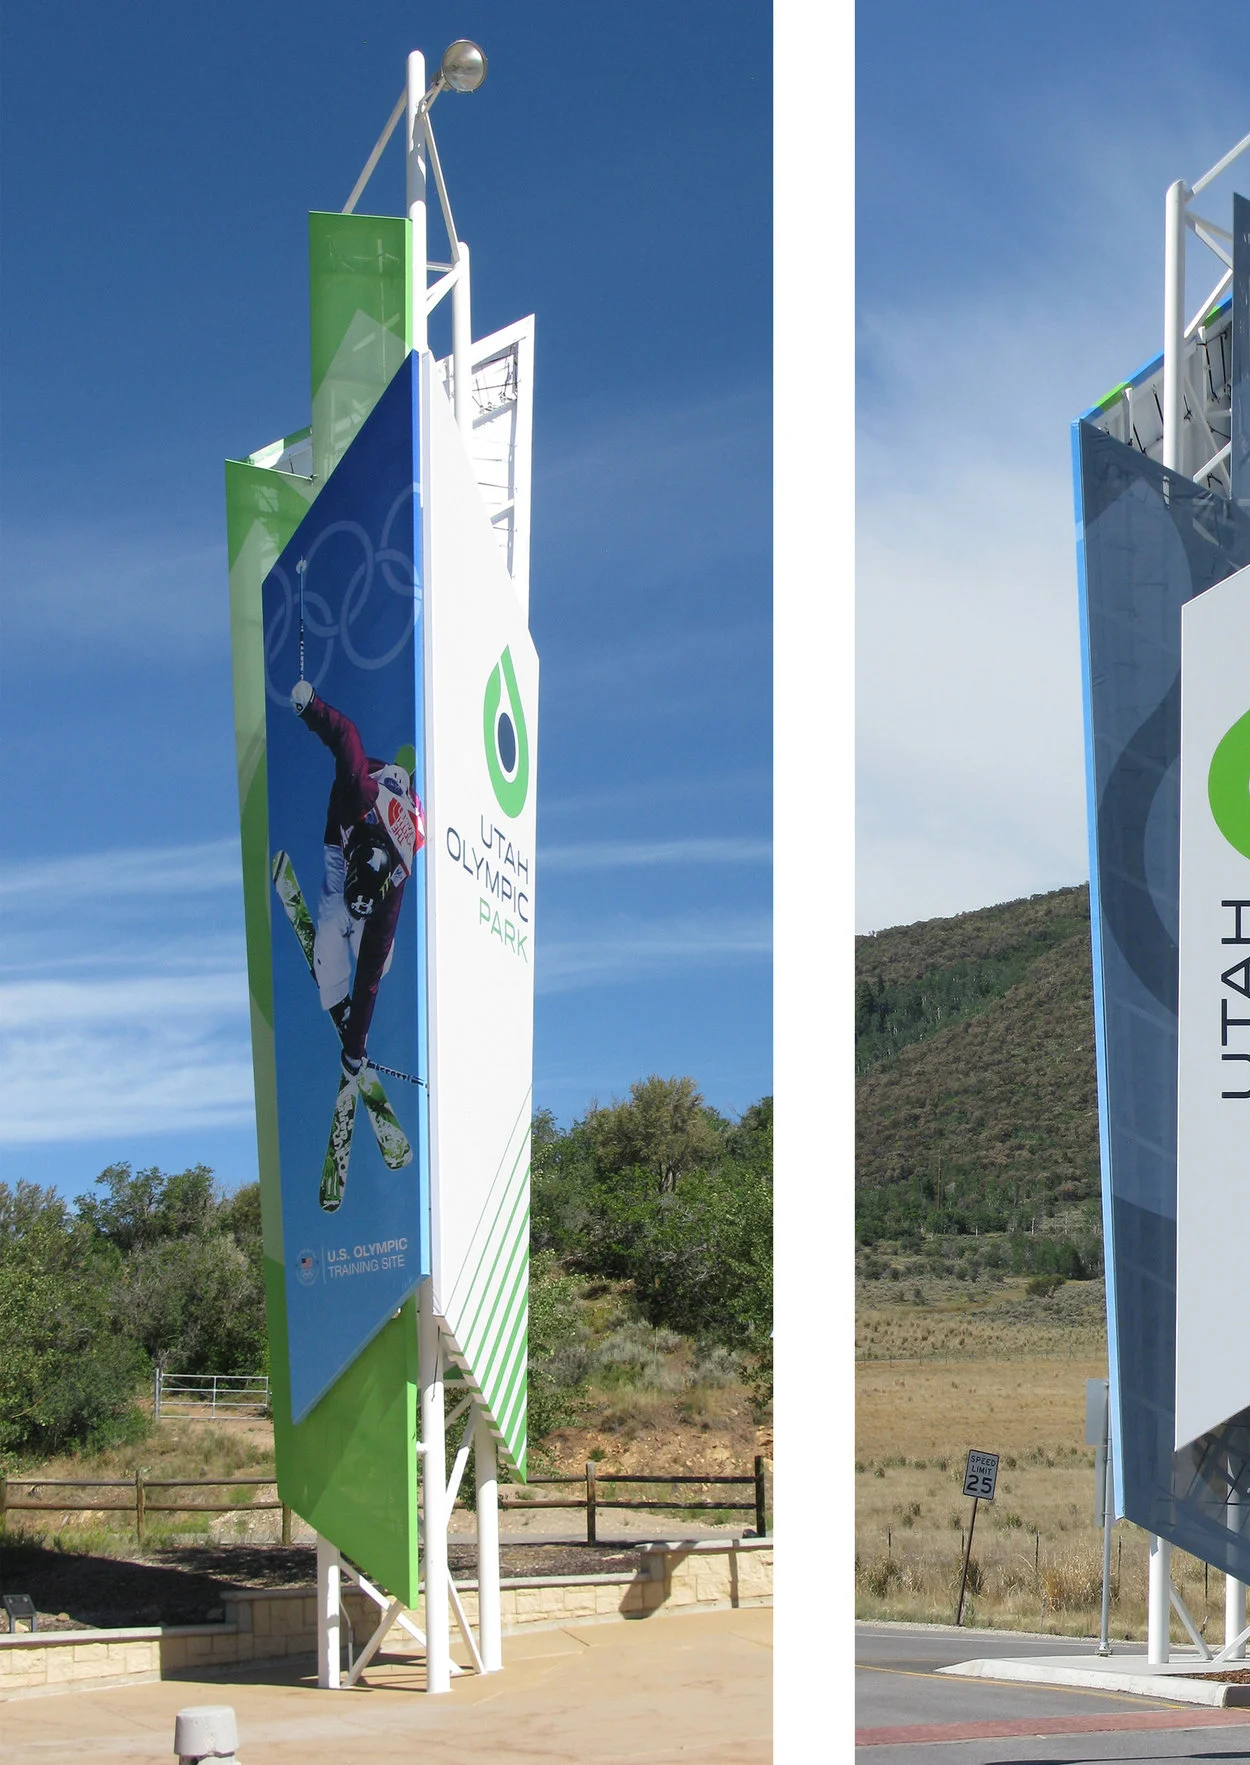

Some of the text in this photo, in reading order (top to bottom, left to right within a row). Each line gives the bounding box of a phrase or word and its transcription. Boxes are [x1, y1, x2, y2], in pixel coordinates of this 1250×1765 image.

[480, 814, 529, 885] UTAH
[446, 827, 529, 923] OLYMPIC
[479, 897, 528, 963] PARK
[327, 1237, 408, 1263] U.S. OLYMPIC
[328, 1254, 405, 1279] TRAINING SITE
[971, 1455, 996, 1467] SPEED
[972, 1465, 992, 1475] LIMIT
[967, 1475, 992, 1493] 25
